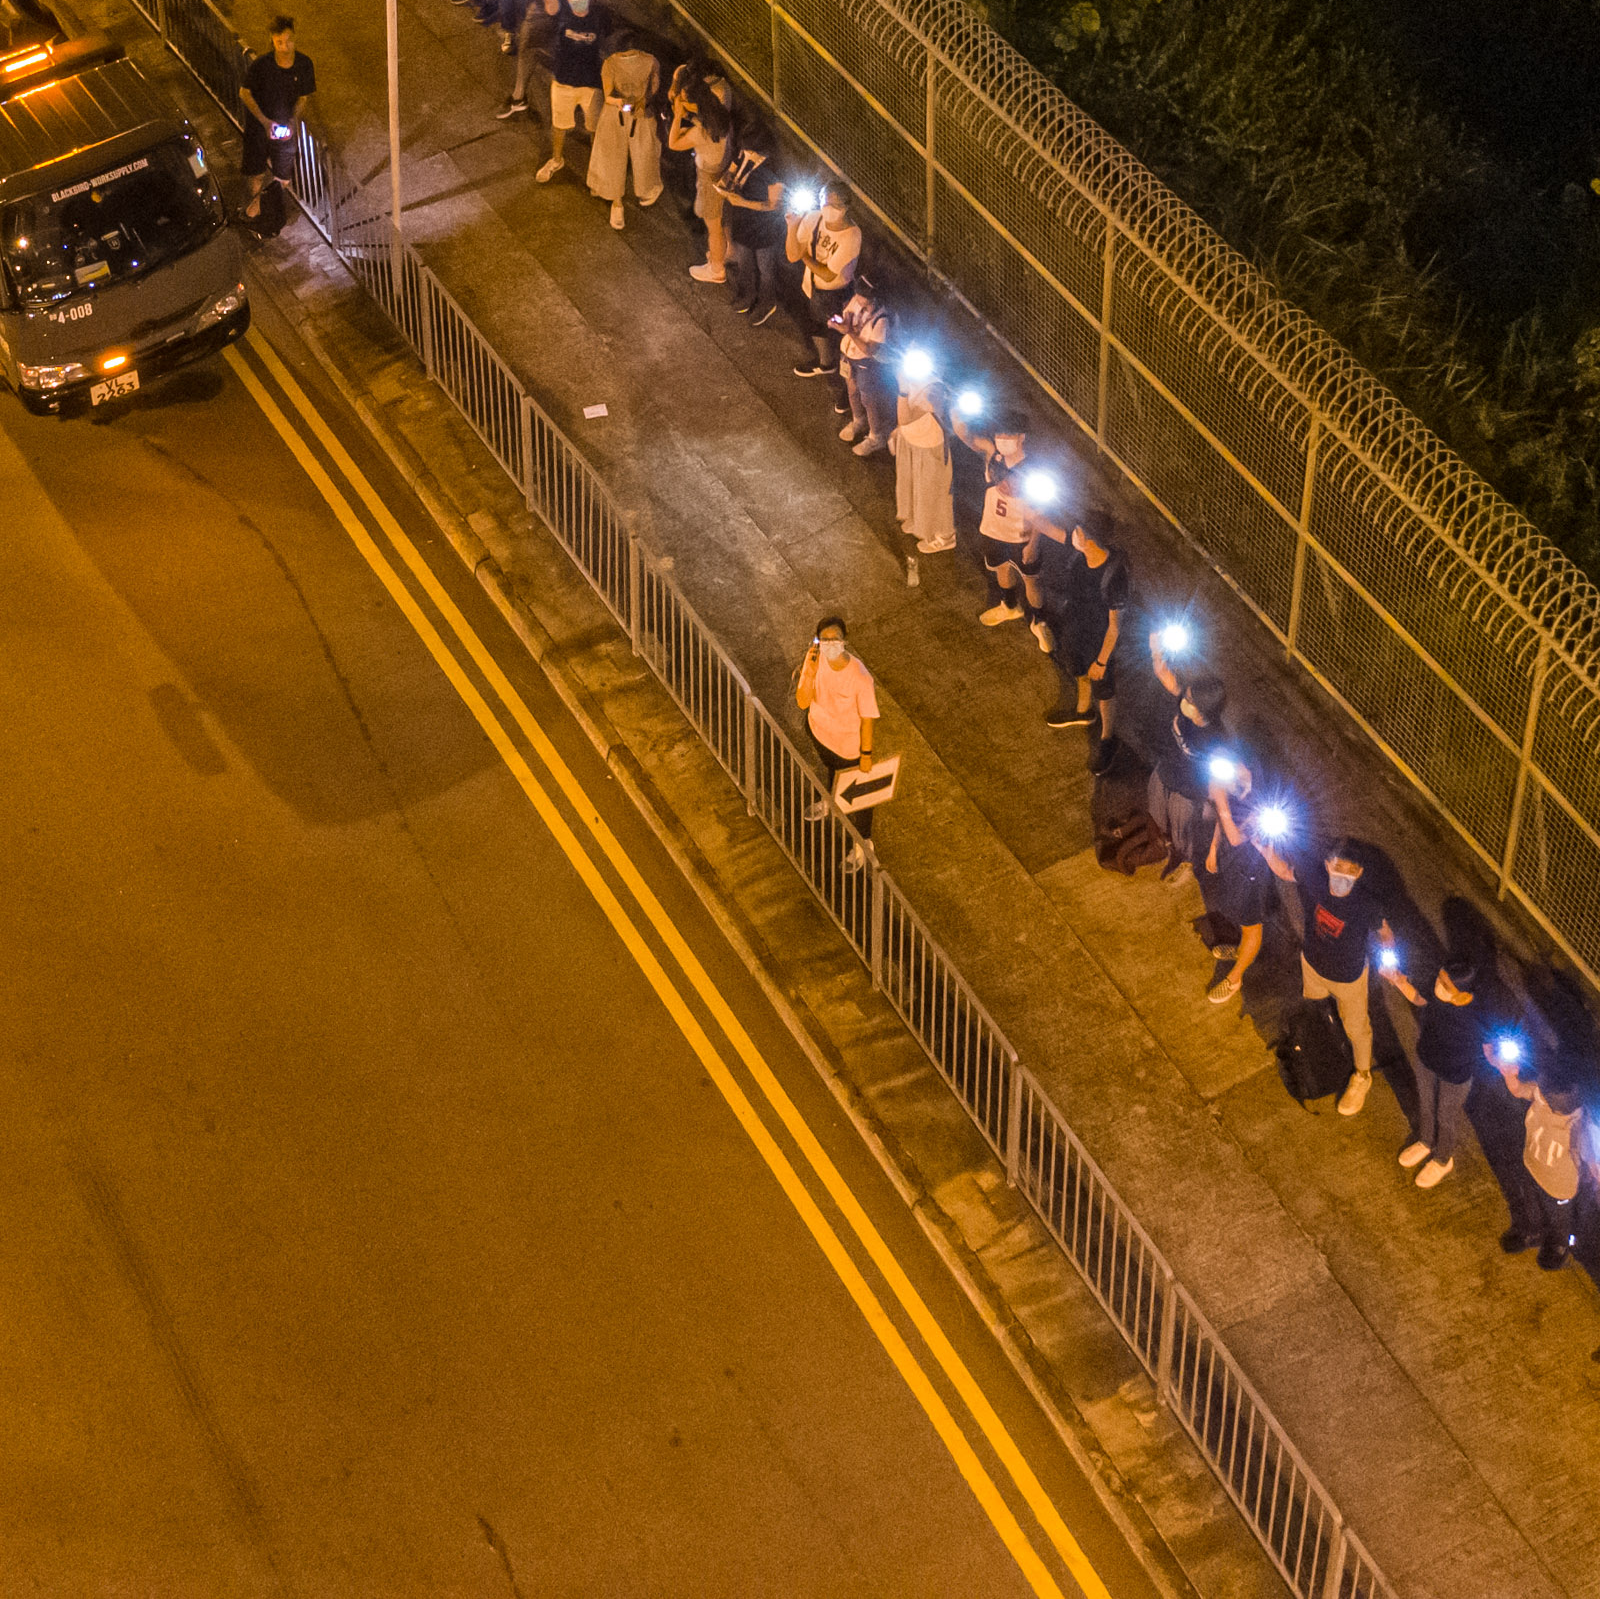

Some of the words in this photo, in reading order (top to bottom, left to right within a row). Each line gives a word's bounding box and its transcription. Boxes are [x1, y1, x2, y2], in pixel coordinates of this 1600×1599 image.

[51, 158, 149, 203] BLACKBIRD-WORKSUPPLY.COM
[97, 382, 135, 401] 2263
[104, 379, 124, 390] VL
[995, 498, 1008, 518] 5
